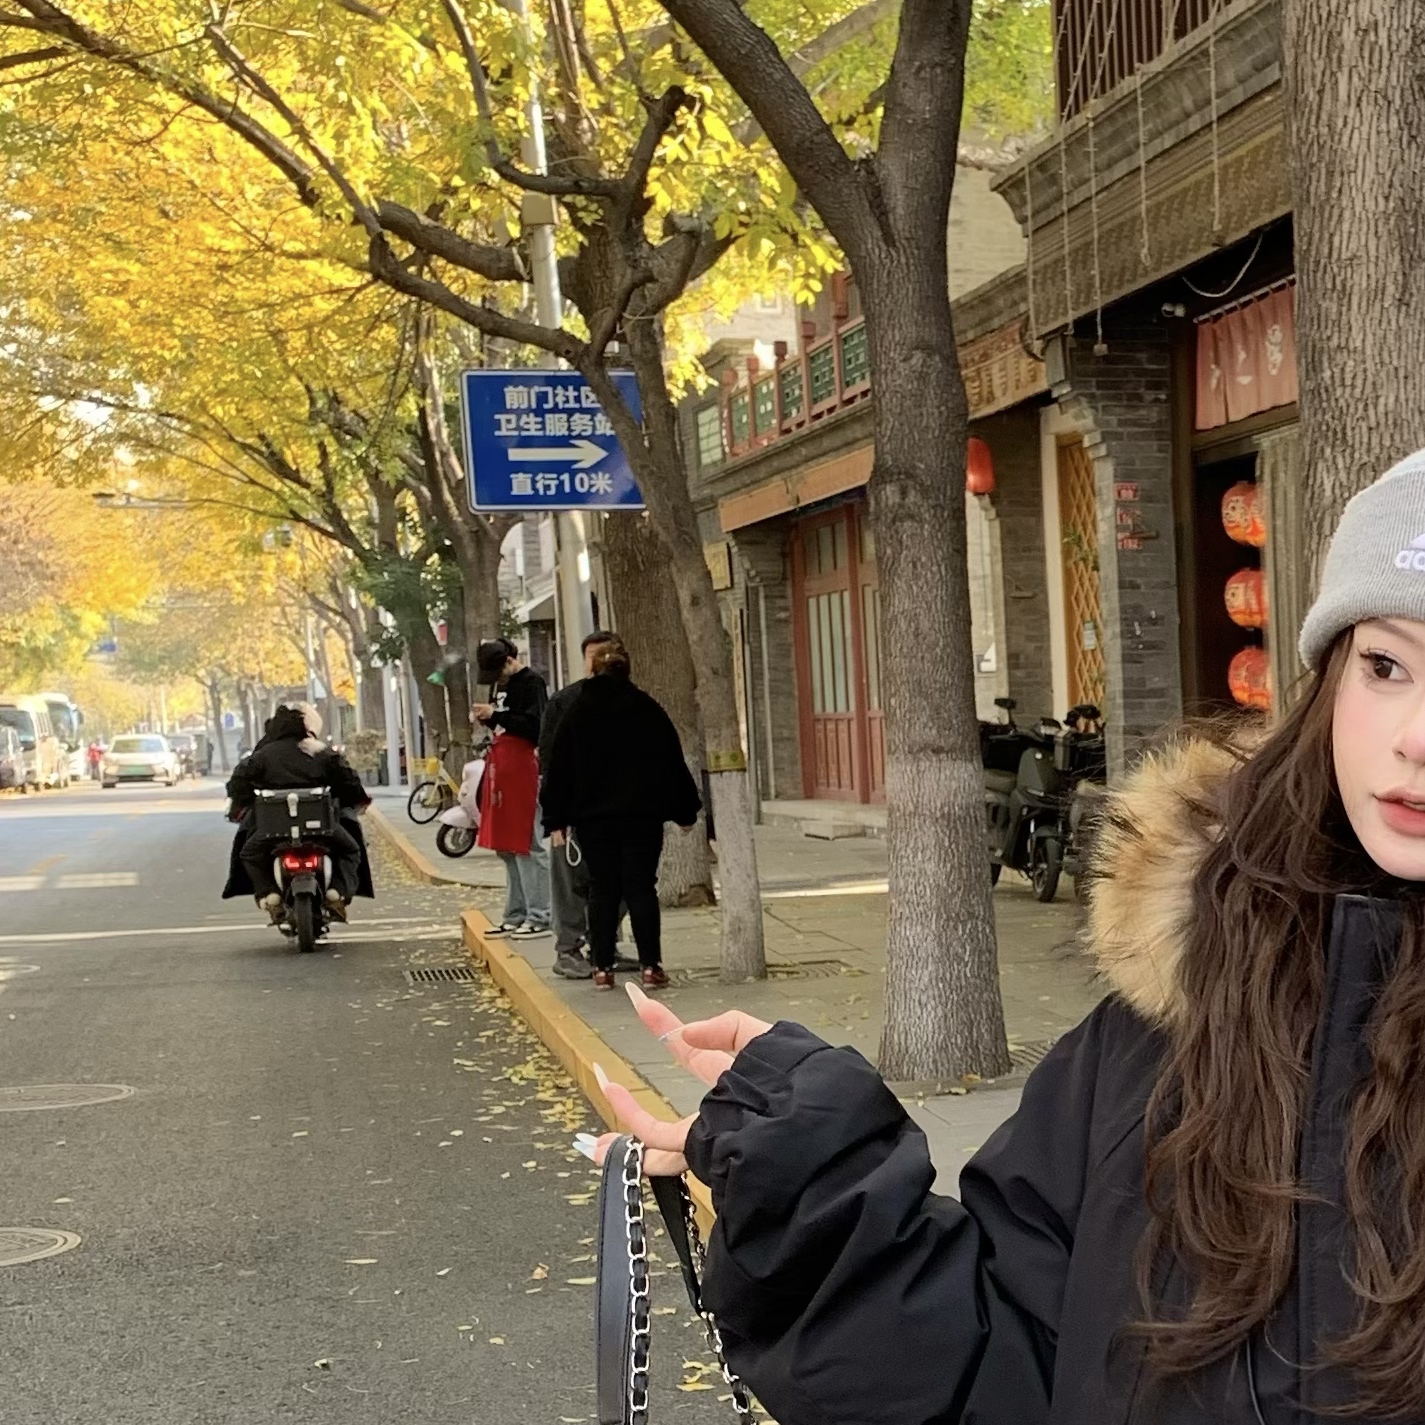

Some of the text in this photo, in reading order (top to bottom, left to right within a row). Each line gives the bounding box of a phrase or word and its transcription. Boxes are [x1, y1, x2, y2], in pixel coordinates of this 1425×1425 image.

[504, 385, 602, 410] 前门社区
[494, 413, 616, 437] 卫生服务站
[510, 472, 613, 496] 直行10米
